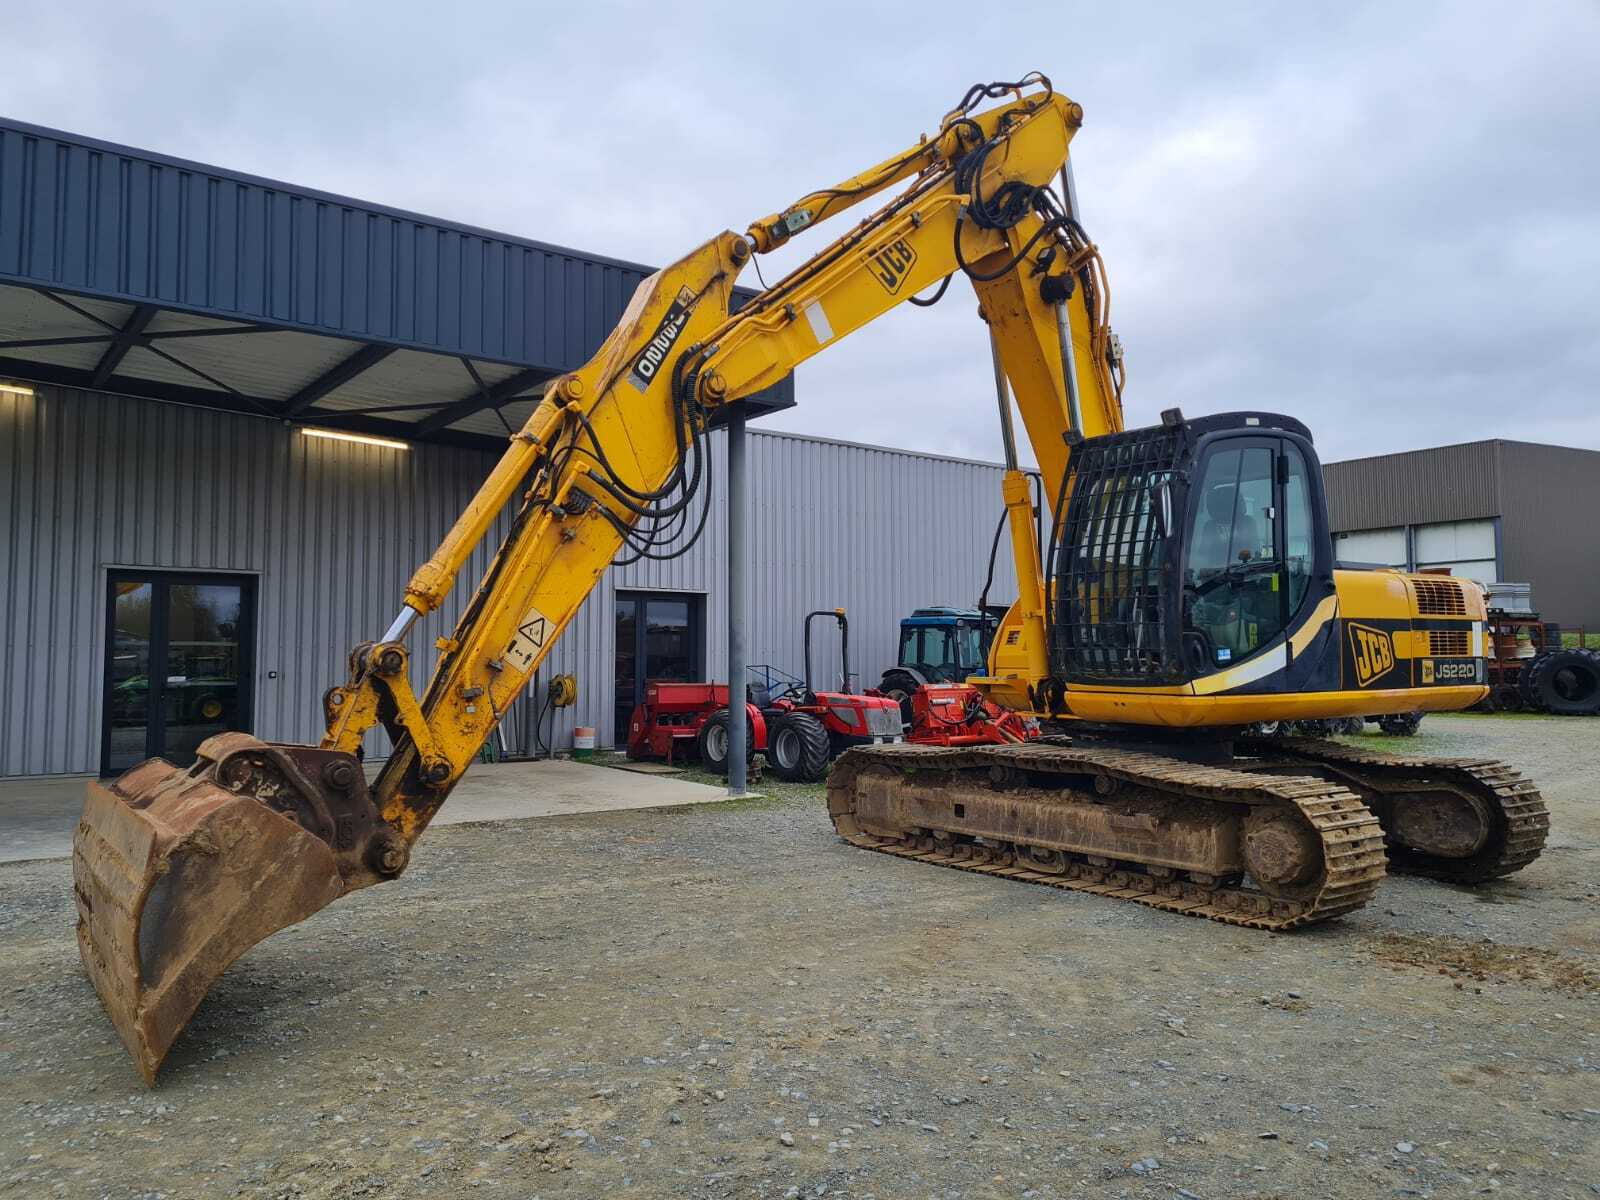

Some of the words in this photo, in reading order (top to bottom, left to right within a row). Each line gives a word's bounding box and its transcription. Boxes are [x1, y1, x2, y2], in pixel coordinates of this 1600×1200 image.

[868, 238, 913, 288] JCB
[1356, 629, 1391, 680] JCB
[1436, 664, 1475, 679] JS220
